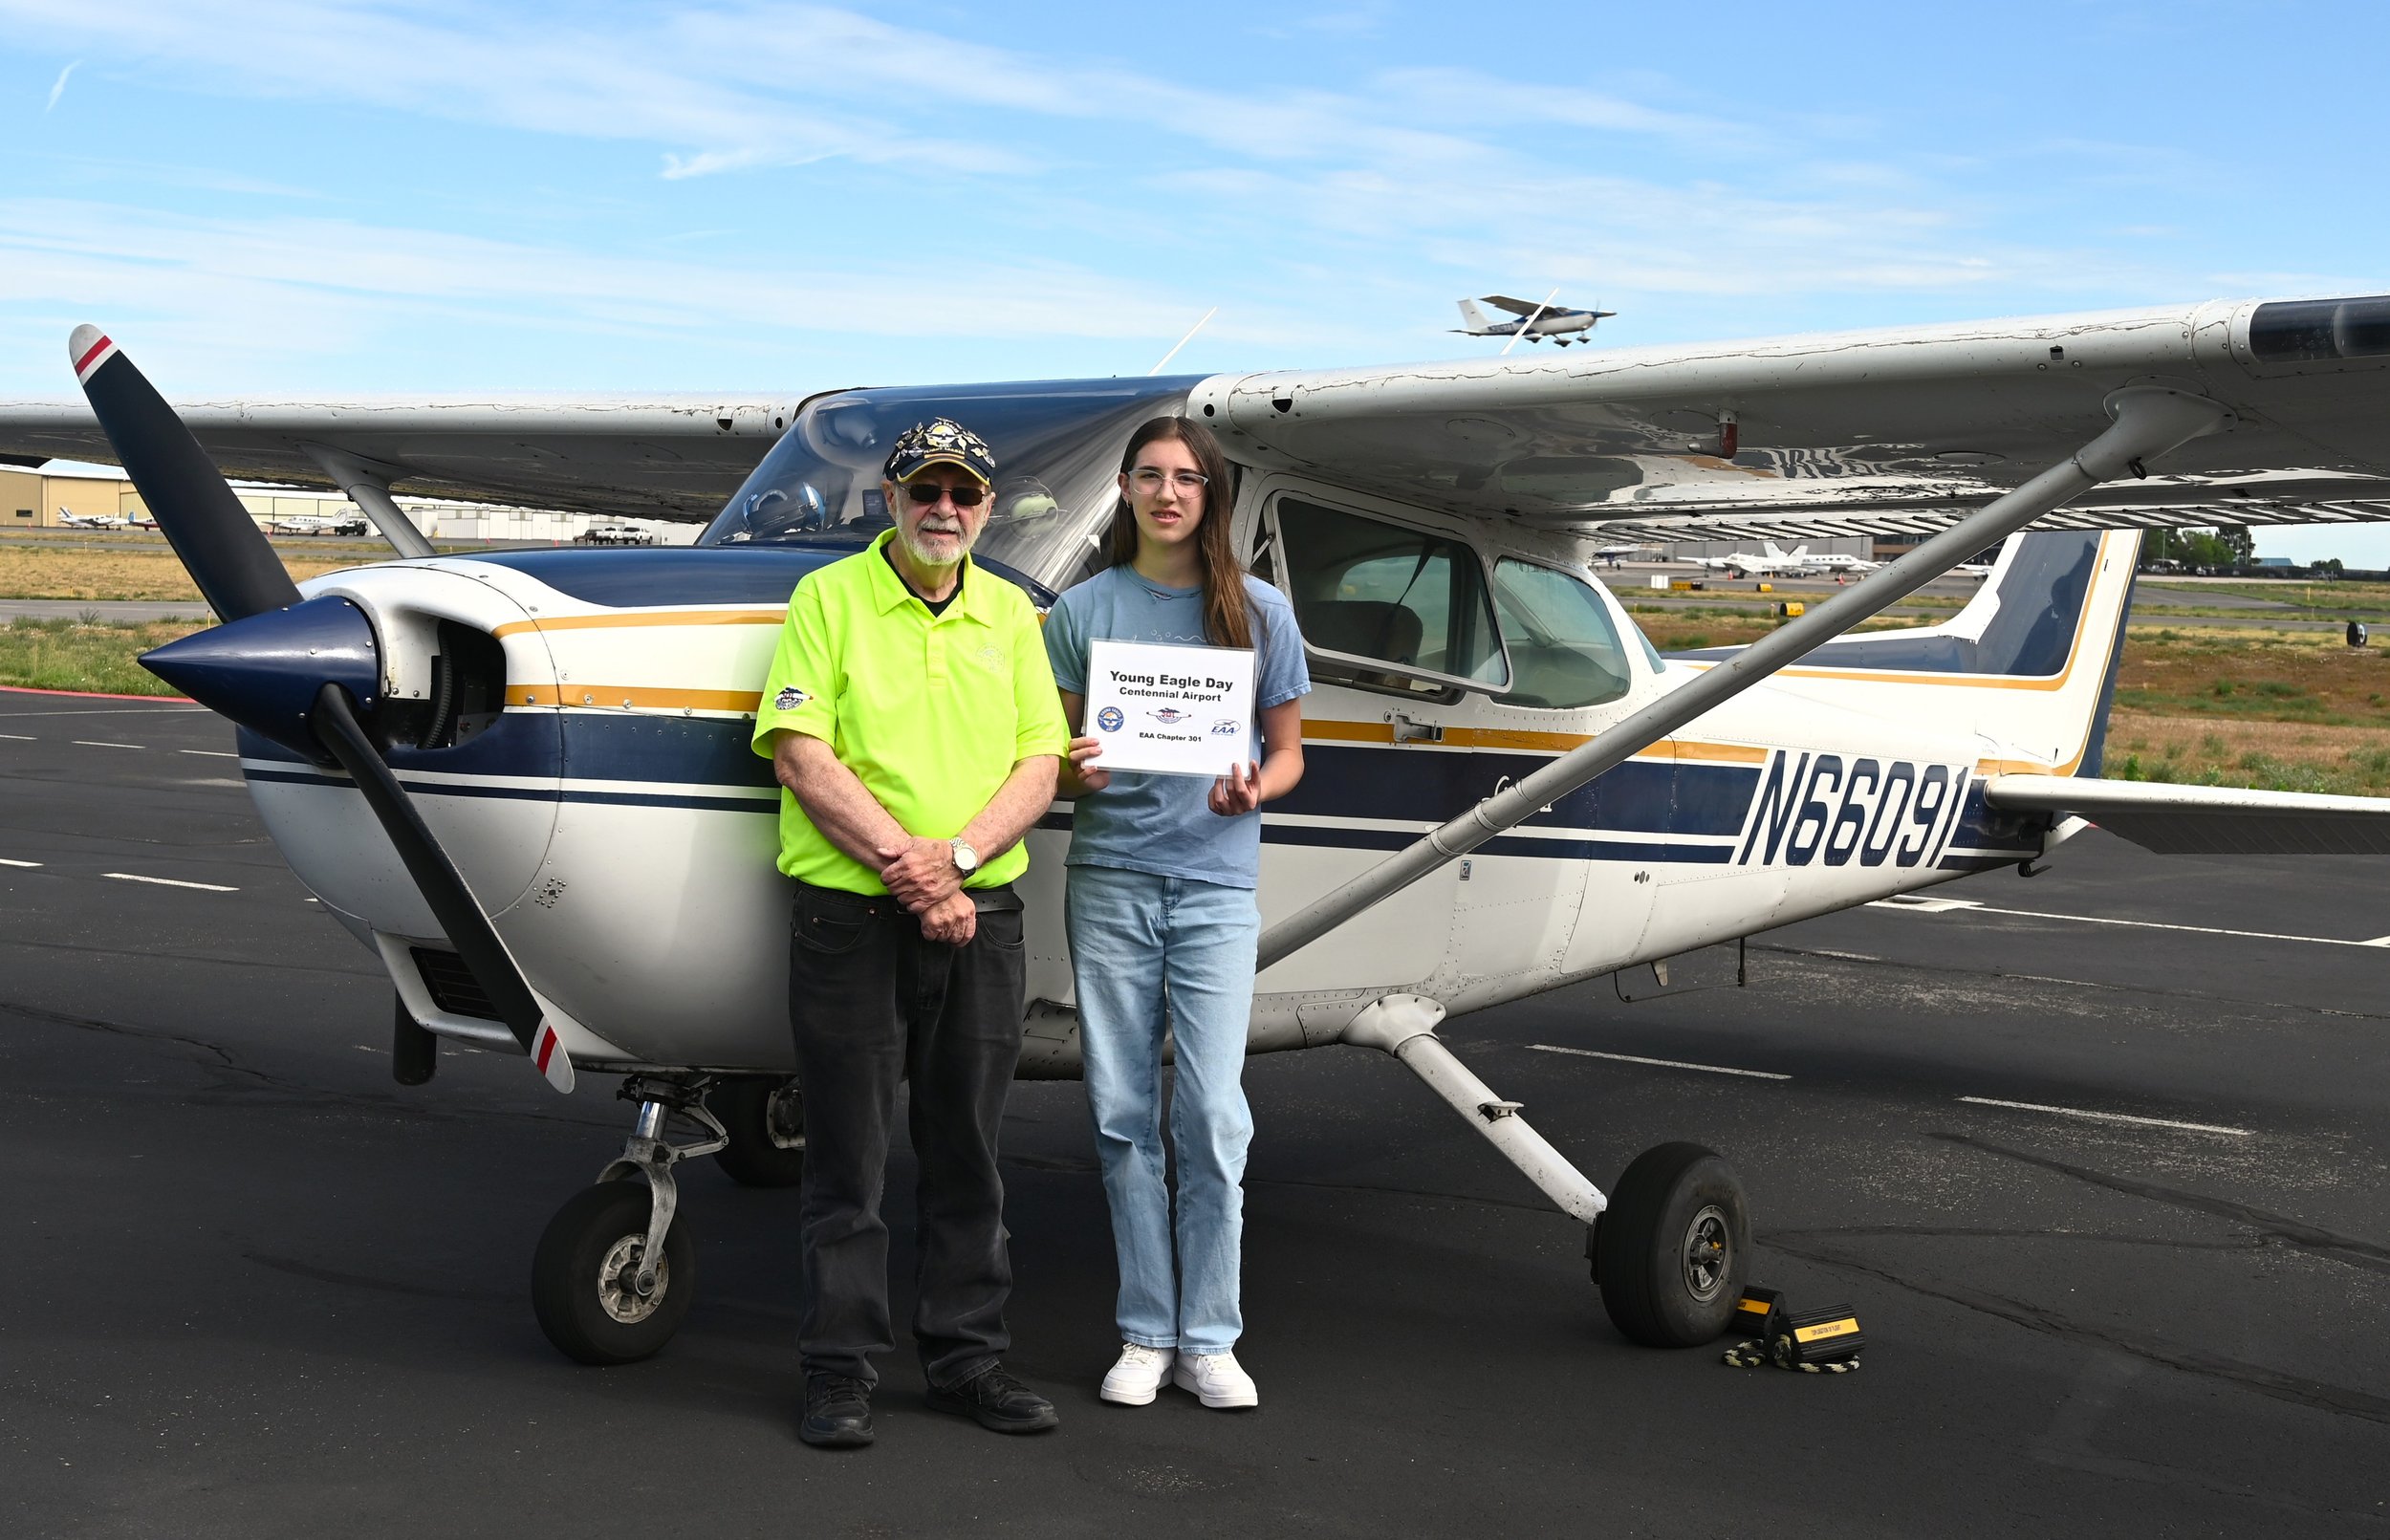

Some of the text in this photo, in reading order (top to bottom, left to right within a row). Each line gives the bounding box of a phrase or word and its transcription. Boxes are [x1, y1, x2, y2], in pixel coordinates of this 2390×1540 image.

[1110, 671, 1233, 692] Young Eagle Day
[1119, 686, 1222, 703] Centennial Airport
[1157, 733, 1186, 742] Chapter
[1211, 726, 1235, 734] EAA
[1737, 749, 1969, 868] N66091
